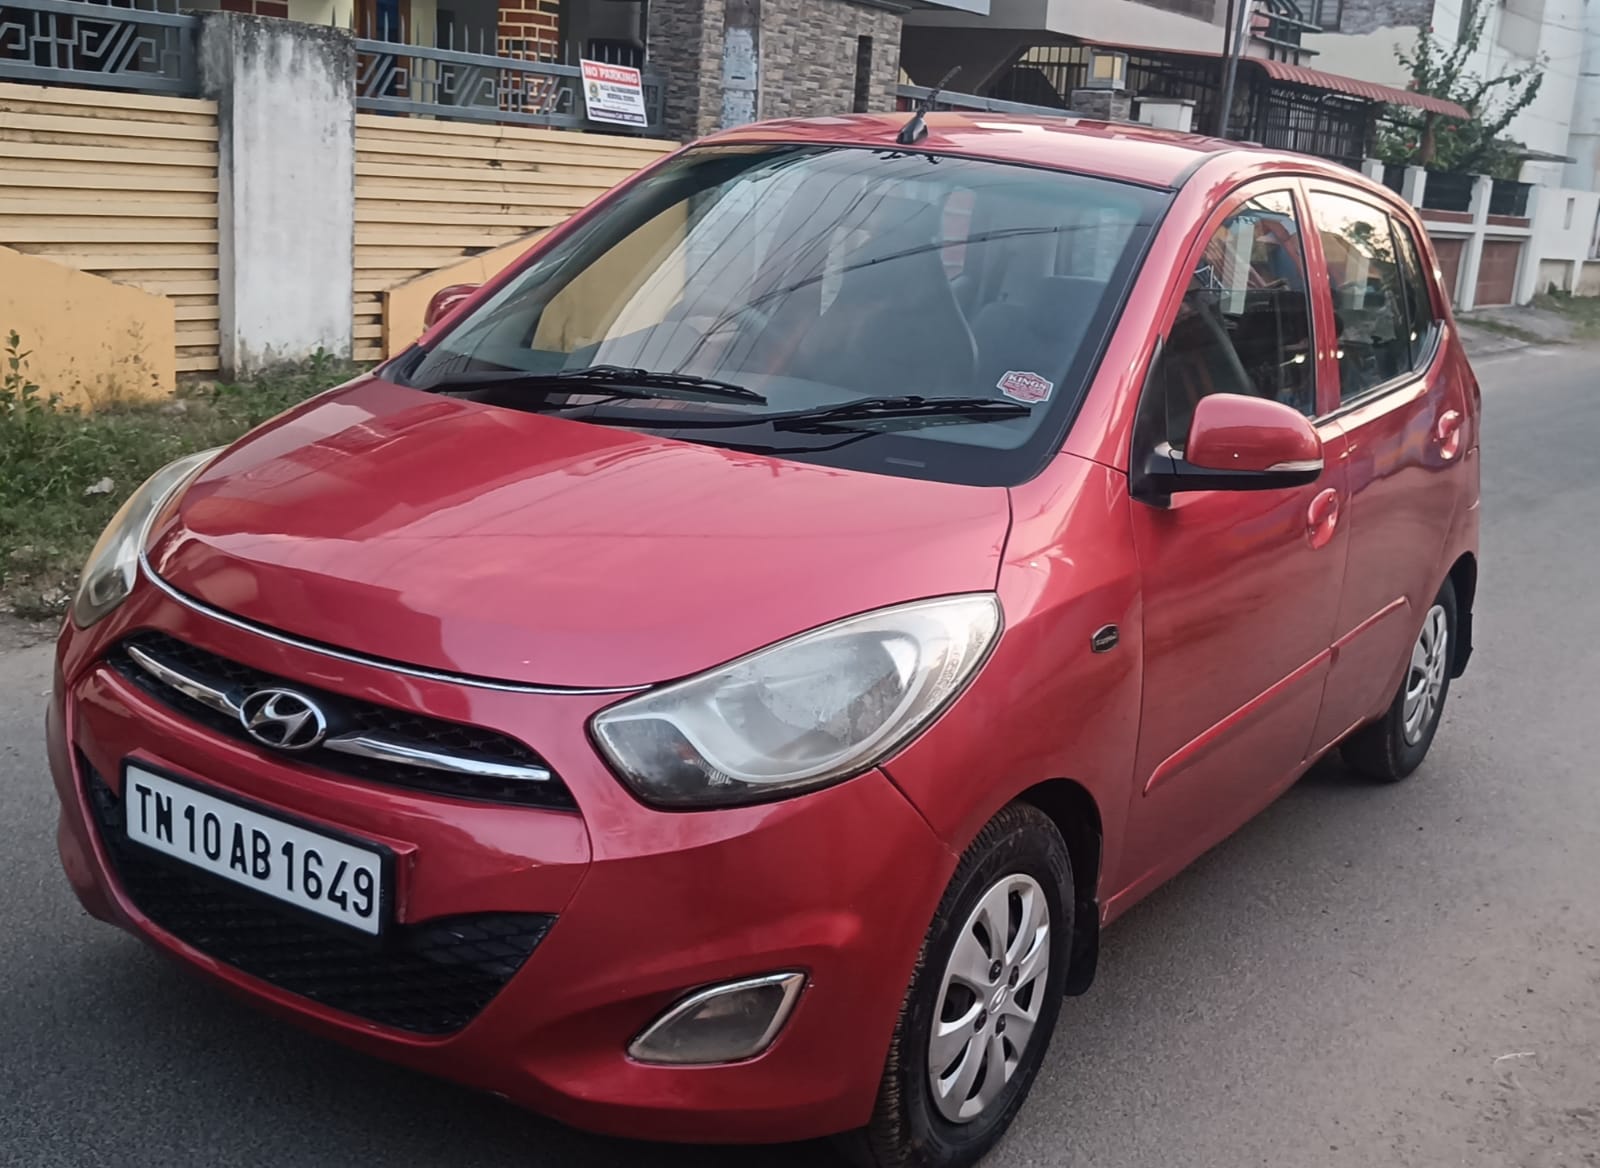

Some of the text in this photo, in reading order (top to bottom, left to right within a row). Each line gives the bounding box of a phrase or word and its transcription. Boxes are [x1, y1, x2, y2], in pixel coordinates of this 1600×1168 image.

[584, 65, 638, 83] NO PARKING
[135, 783, 375, 918] TN 10 AB 1649
